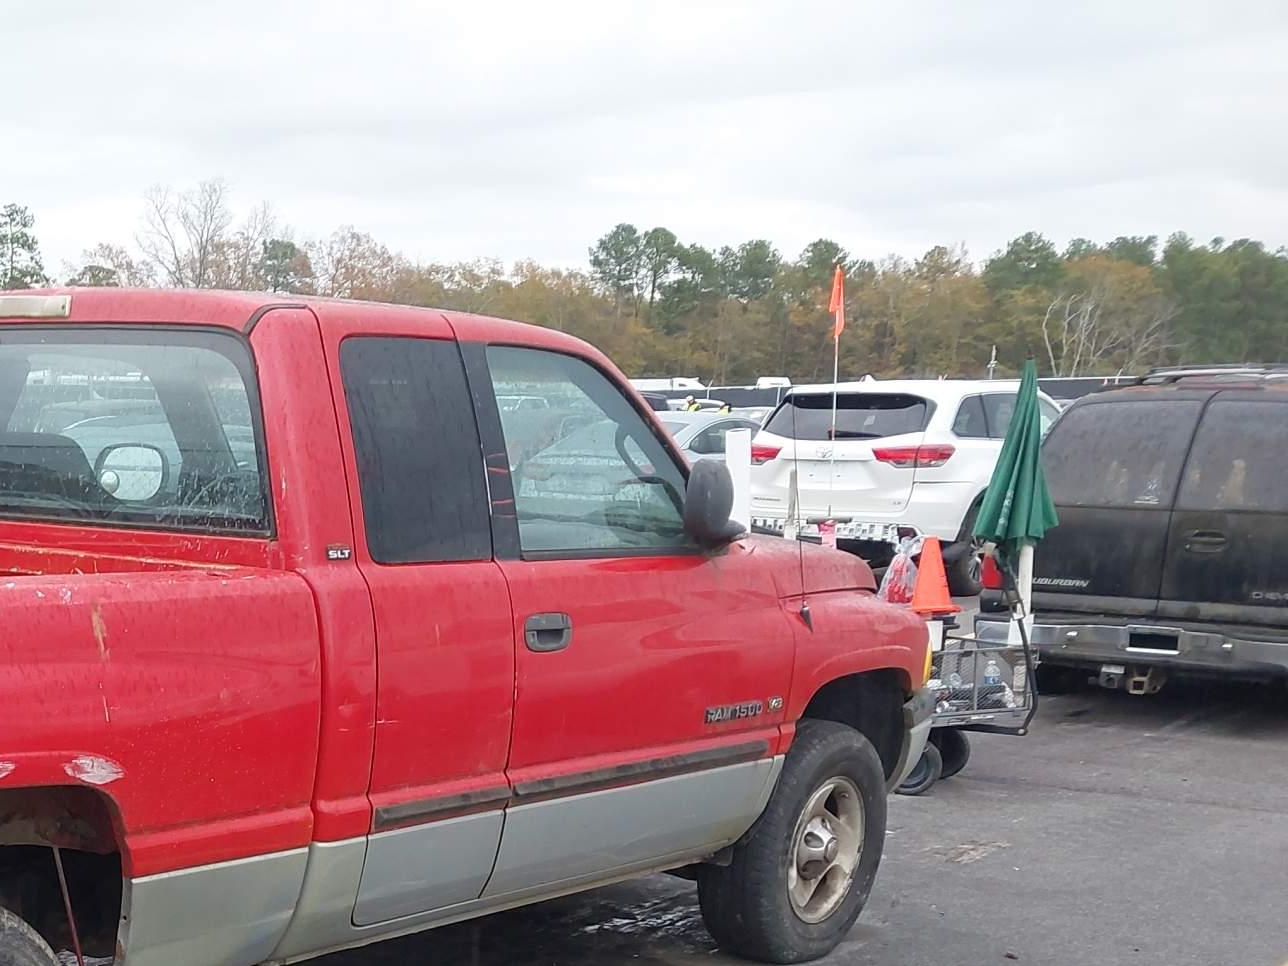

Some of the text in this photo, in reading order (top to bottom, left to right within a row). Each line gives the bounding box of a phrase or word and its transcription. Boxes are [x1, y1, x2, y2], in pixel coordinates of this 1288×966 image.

[327, 549, 351, 559] SLT
[1031, 576, 1090, 588] UBURBAN
[706, 701, 764, 723] RAM 1500
